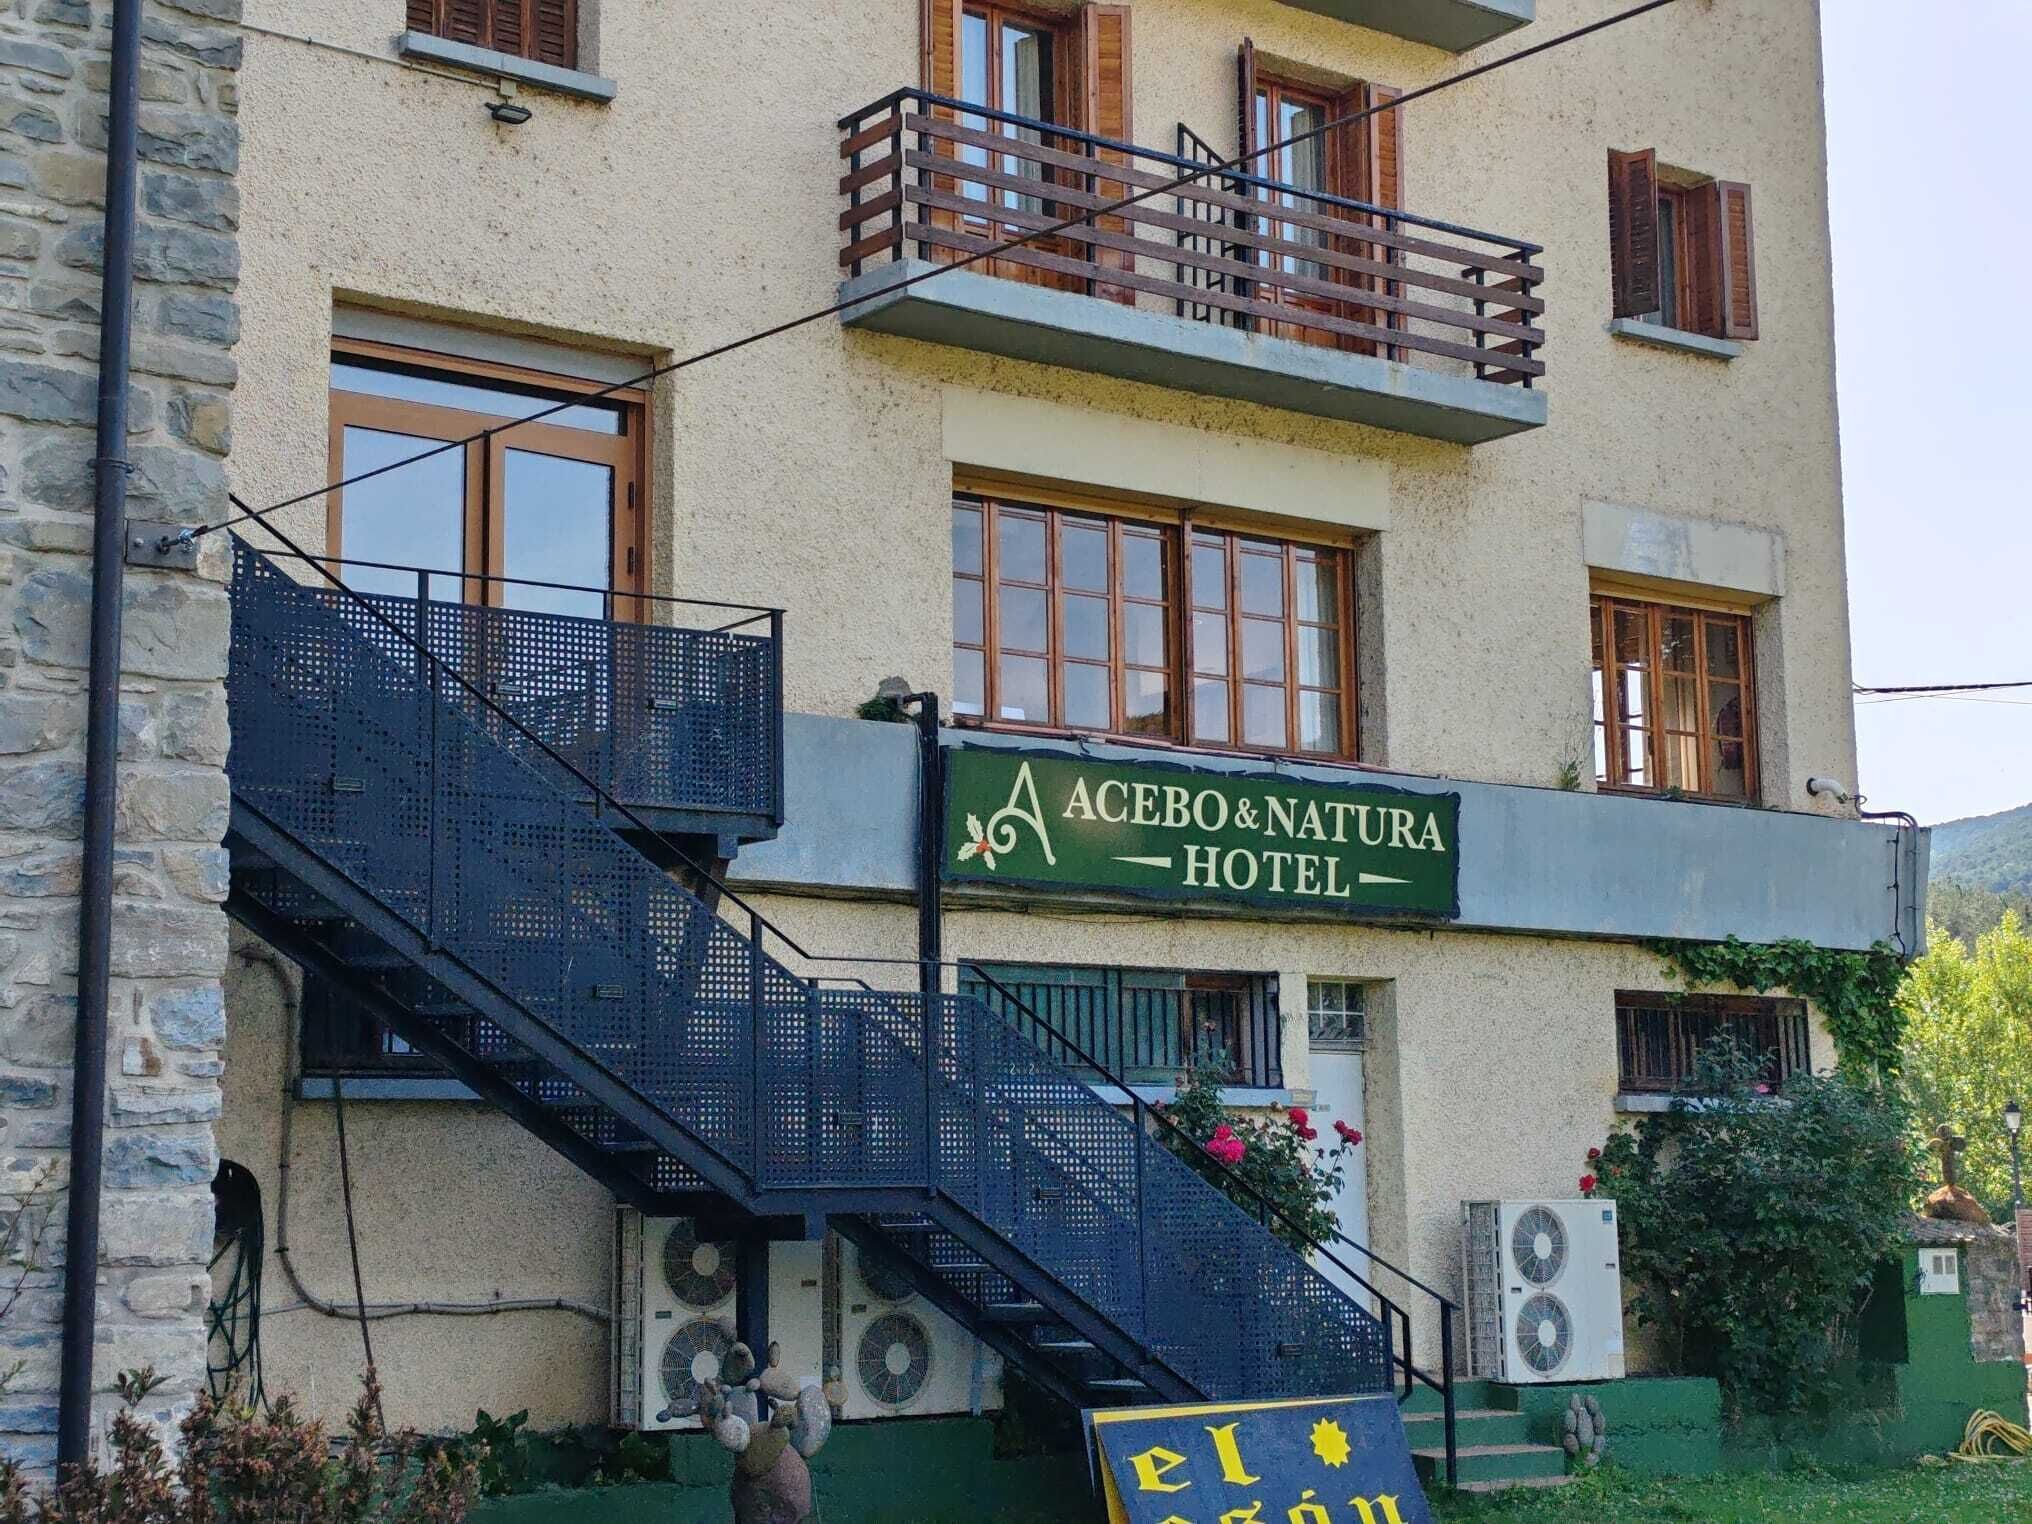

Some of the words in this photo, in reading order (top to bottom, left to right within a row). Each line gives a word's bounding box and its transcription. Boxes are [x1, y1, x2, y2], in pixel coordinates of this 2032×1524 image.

[1061, 776, 1229, 832] ACEBO
[1263, 795, 1446, 852] NATURA
[1182, 844, 1350, 898] HOTEL
[1127, 1421, 1262, 1493] el
